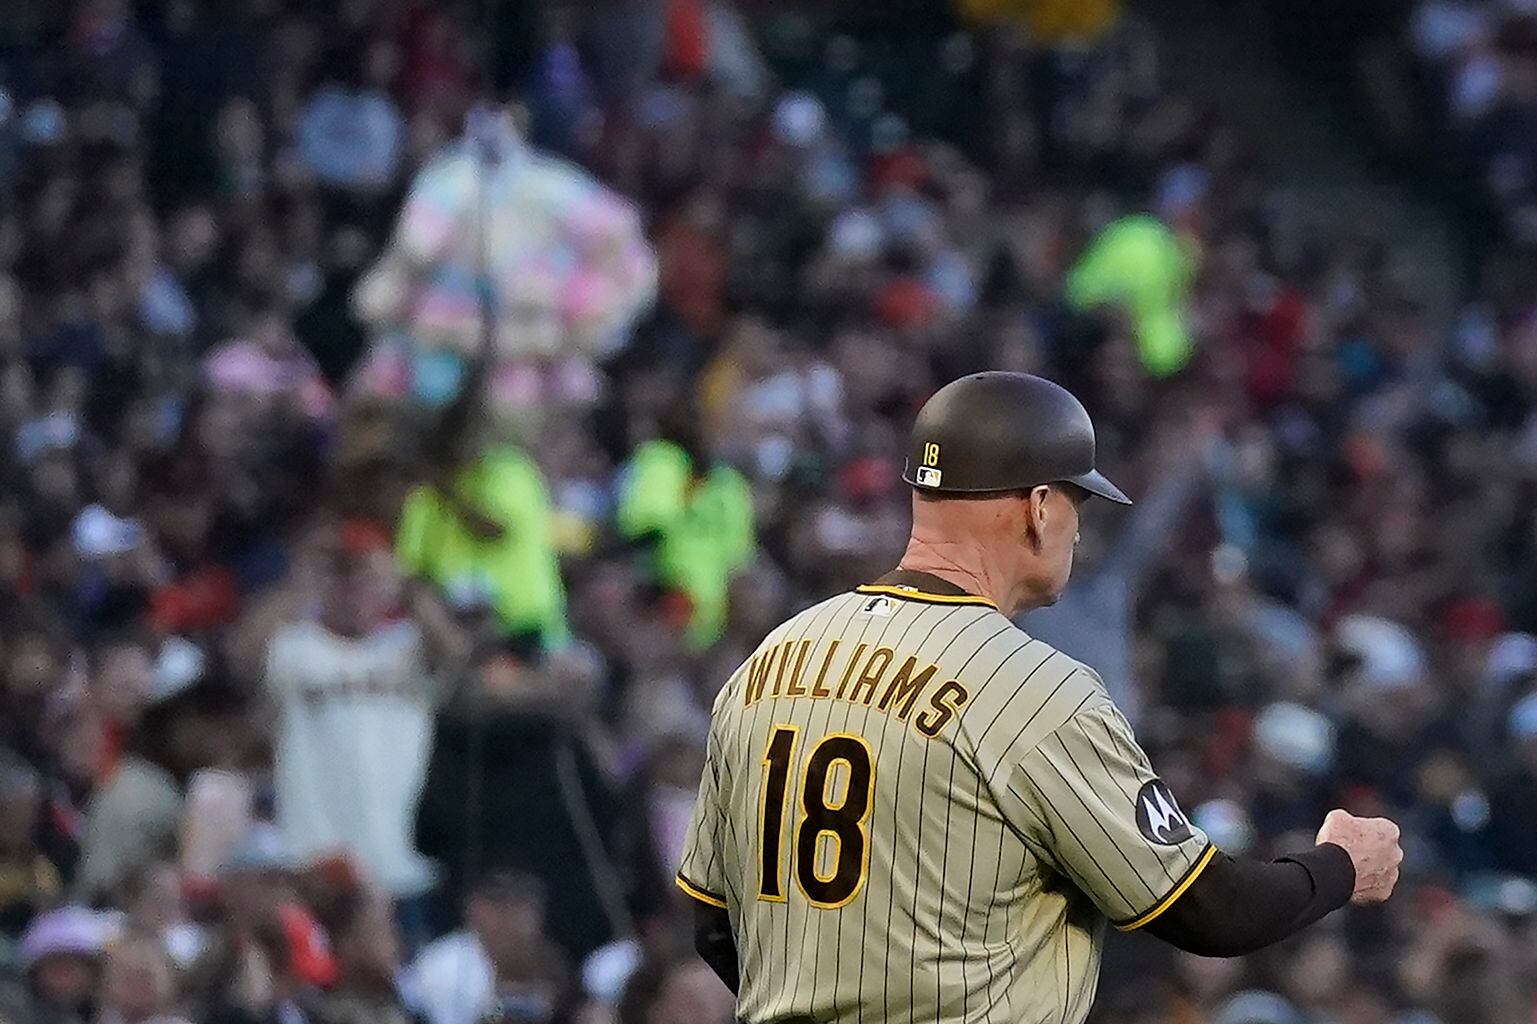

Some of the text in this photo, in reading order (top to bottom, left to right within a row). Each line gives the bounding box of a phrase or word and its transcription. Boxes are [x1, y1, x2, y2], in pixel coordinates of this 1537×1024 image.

[923, 442, 940, 467] 18
[743, 639, 969, 740] WILLIAMS
[757, 723, 877, 910] 18
